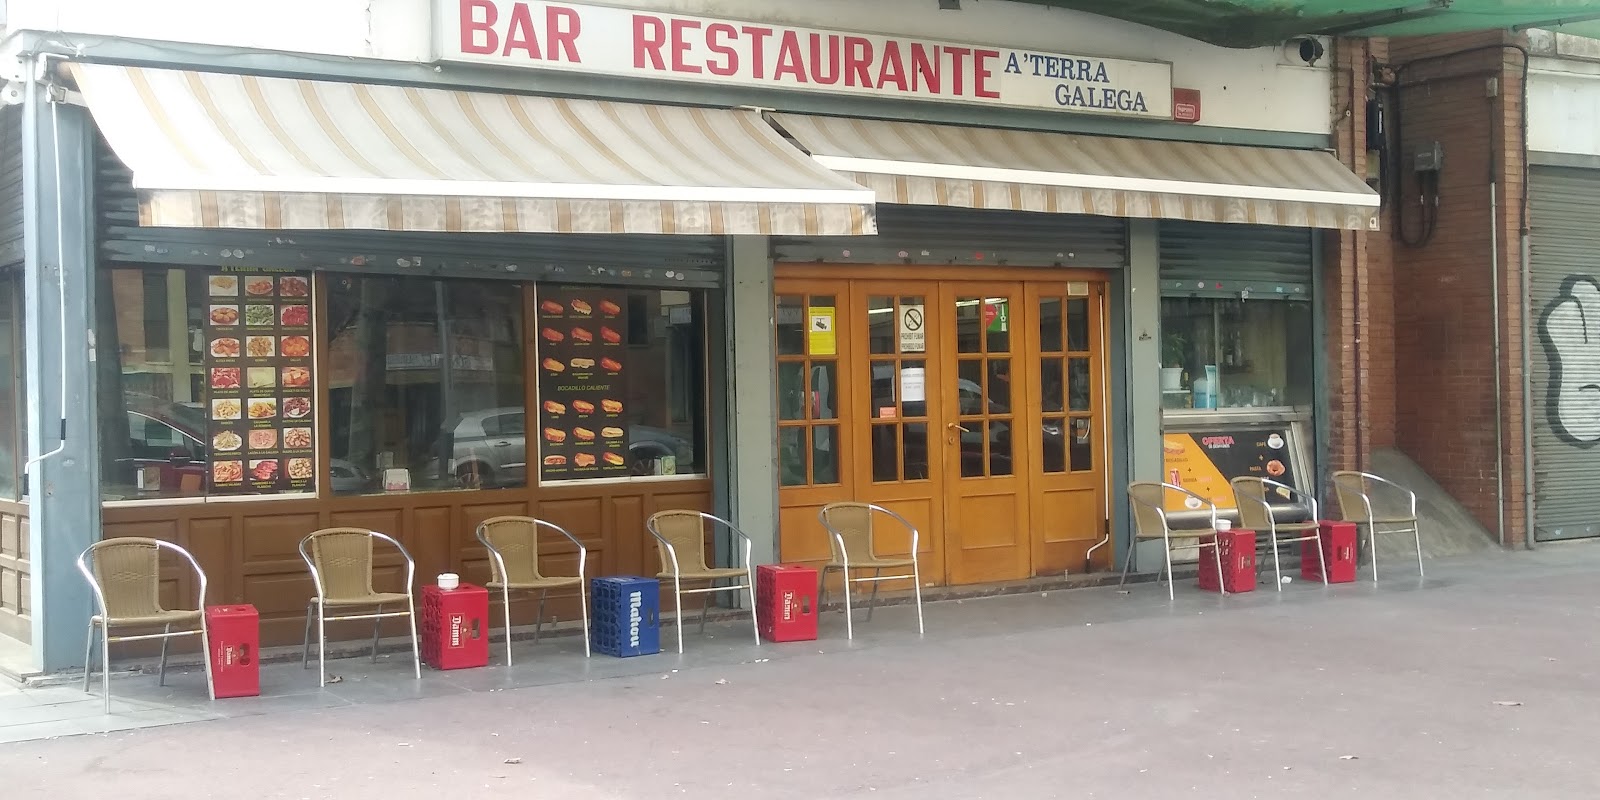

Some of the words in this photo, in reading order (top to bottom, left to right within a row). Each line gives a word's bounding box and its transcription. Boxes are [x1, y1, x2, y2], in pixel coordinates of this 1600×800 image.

[459, 0, 582, 64] BAR
[632, 14, 1001, 99] RESTAURANTE
[1004, 51, 1110, 83] A'TERRA
[1054, 83, 1149, 113] GALEGA
[1202, 436, 1235, 446] OFERTA
[629, 590, 643, 648] Mahou
[784, 591, 793, 620] Damm
[451, 615, 462, 647] Damm
